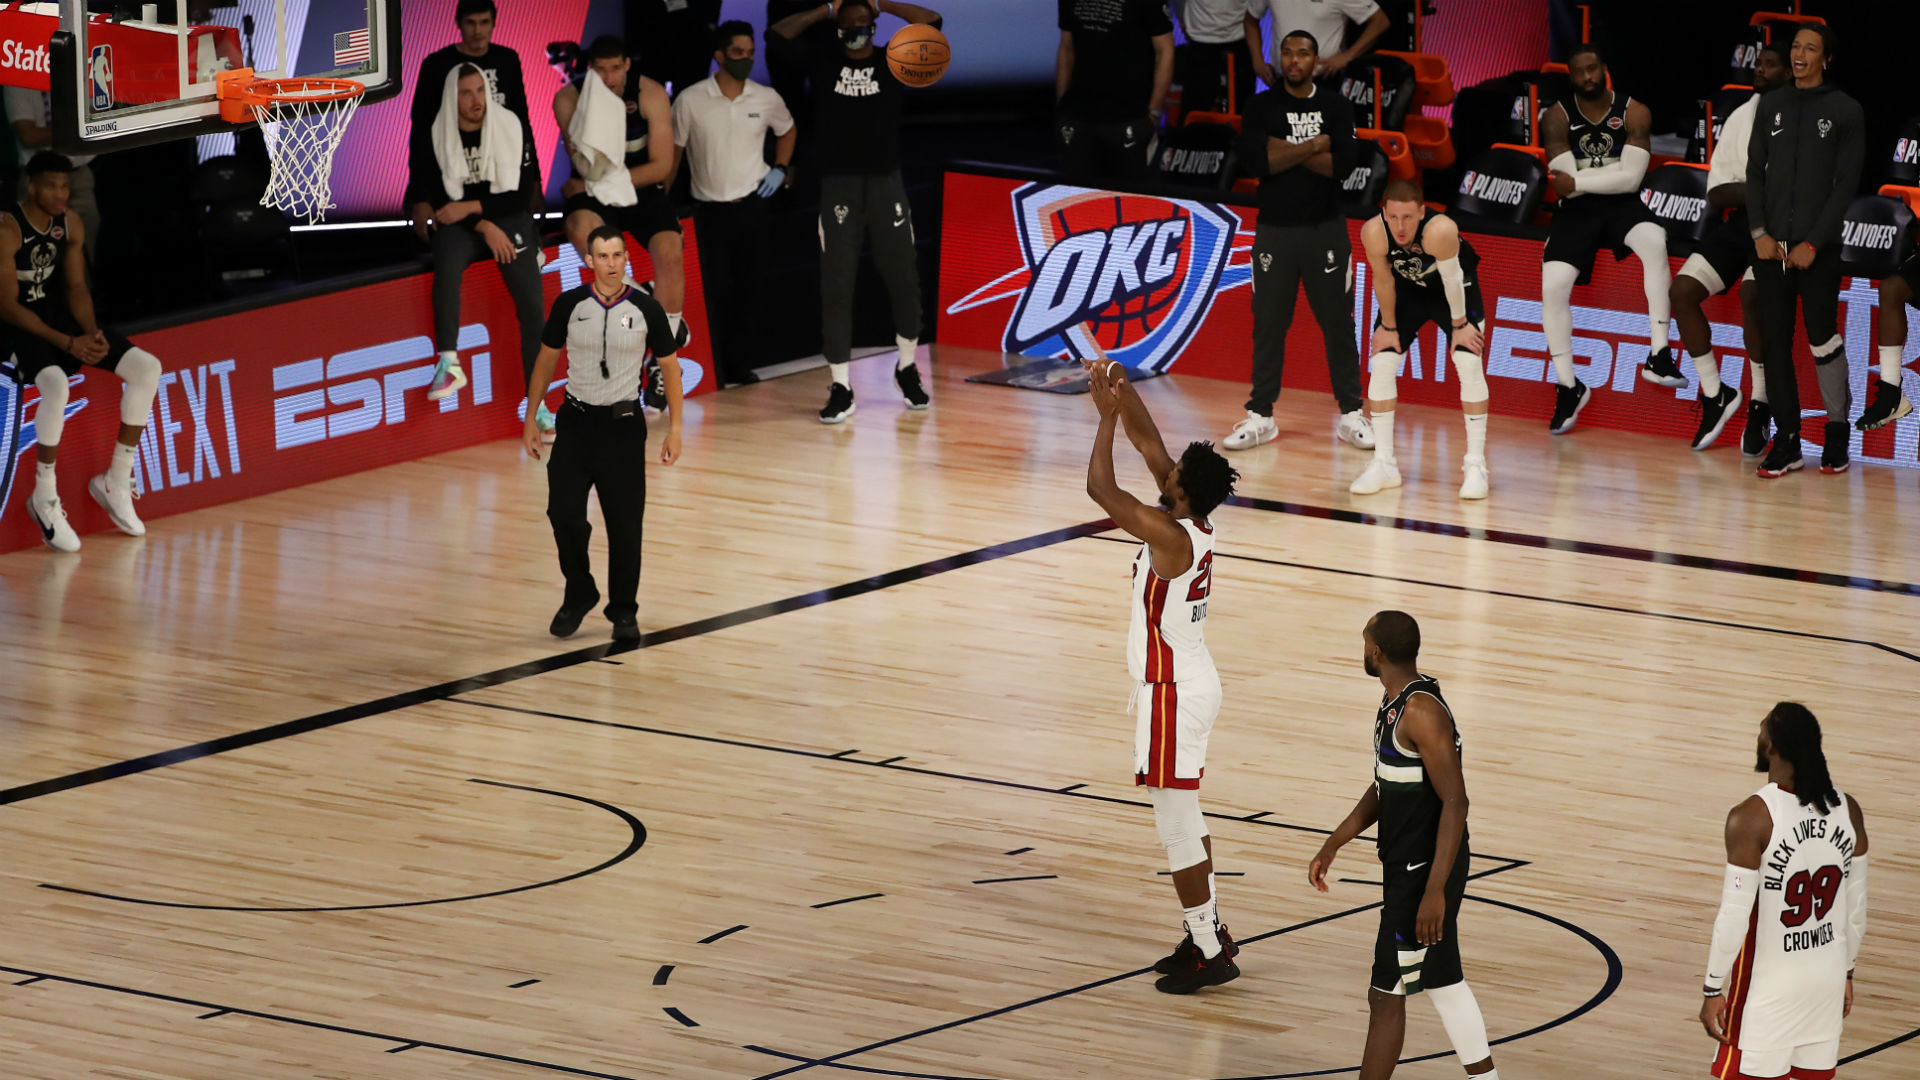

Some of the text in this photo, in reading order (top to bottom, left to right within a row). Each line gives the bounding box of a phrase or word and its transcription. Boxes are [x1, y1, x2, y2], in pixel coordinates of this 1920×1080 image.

[834, 80, 881, 97] MATTER
[85, 121, 117, 136] SPALDING
[1286, 111, 1324, 125] BLACK
[1292, 123, 1321, 137] LIVES
[1170, 149, 1225, 174] PLAYOFFS
[1470, 173, 1528, 206] PLAYOFFS
[1648, 190, 1707, 222] PLAYOFFS
[1014, 218, 1189, 344] OKC
[1486, 296, 1746, 401] ESPN
[272, 322, 493, 451] ESPN
[1764, 839, 1796, 891] BLACK
[1793, 818, 1827, 845] LIVES
[1779, 864, 1844, 929] 99
[1783, 922, 1835, 952] CROWDER
